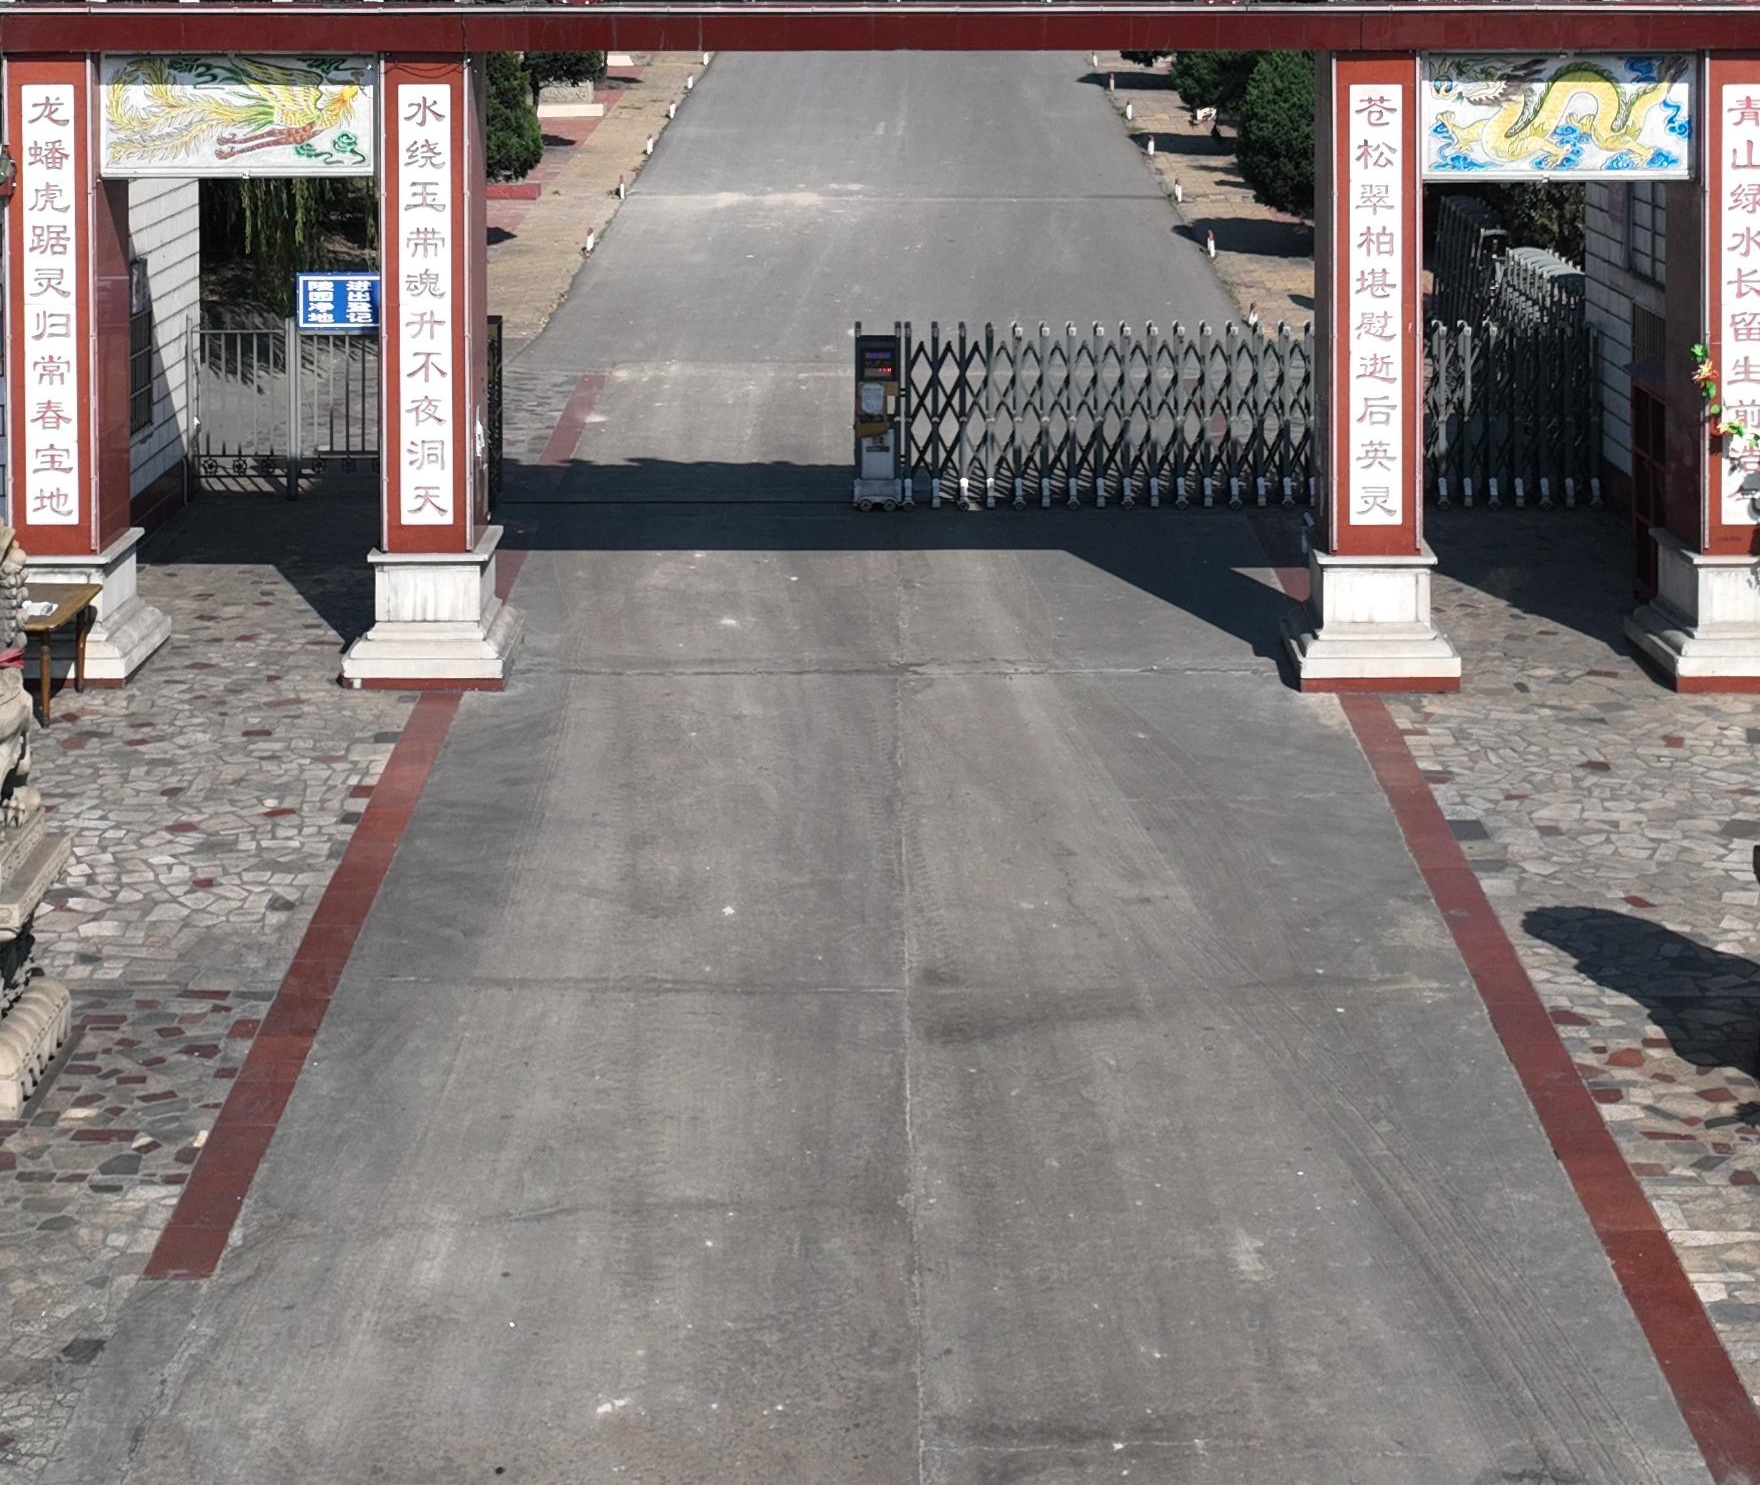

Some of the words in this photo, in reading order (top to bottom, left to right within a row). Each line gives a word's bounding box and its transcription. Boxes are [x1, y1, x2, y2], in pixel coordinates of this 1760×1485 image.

[27, 94, 75, 518] 龙蟠虎踞灵归常春宝地
[403, 94, 449, 517] 水绕玉带魂升不夜洞天
[1353, 94, 1399, 518] 苍松翠柏堪慰逝后英灵
